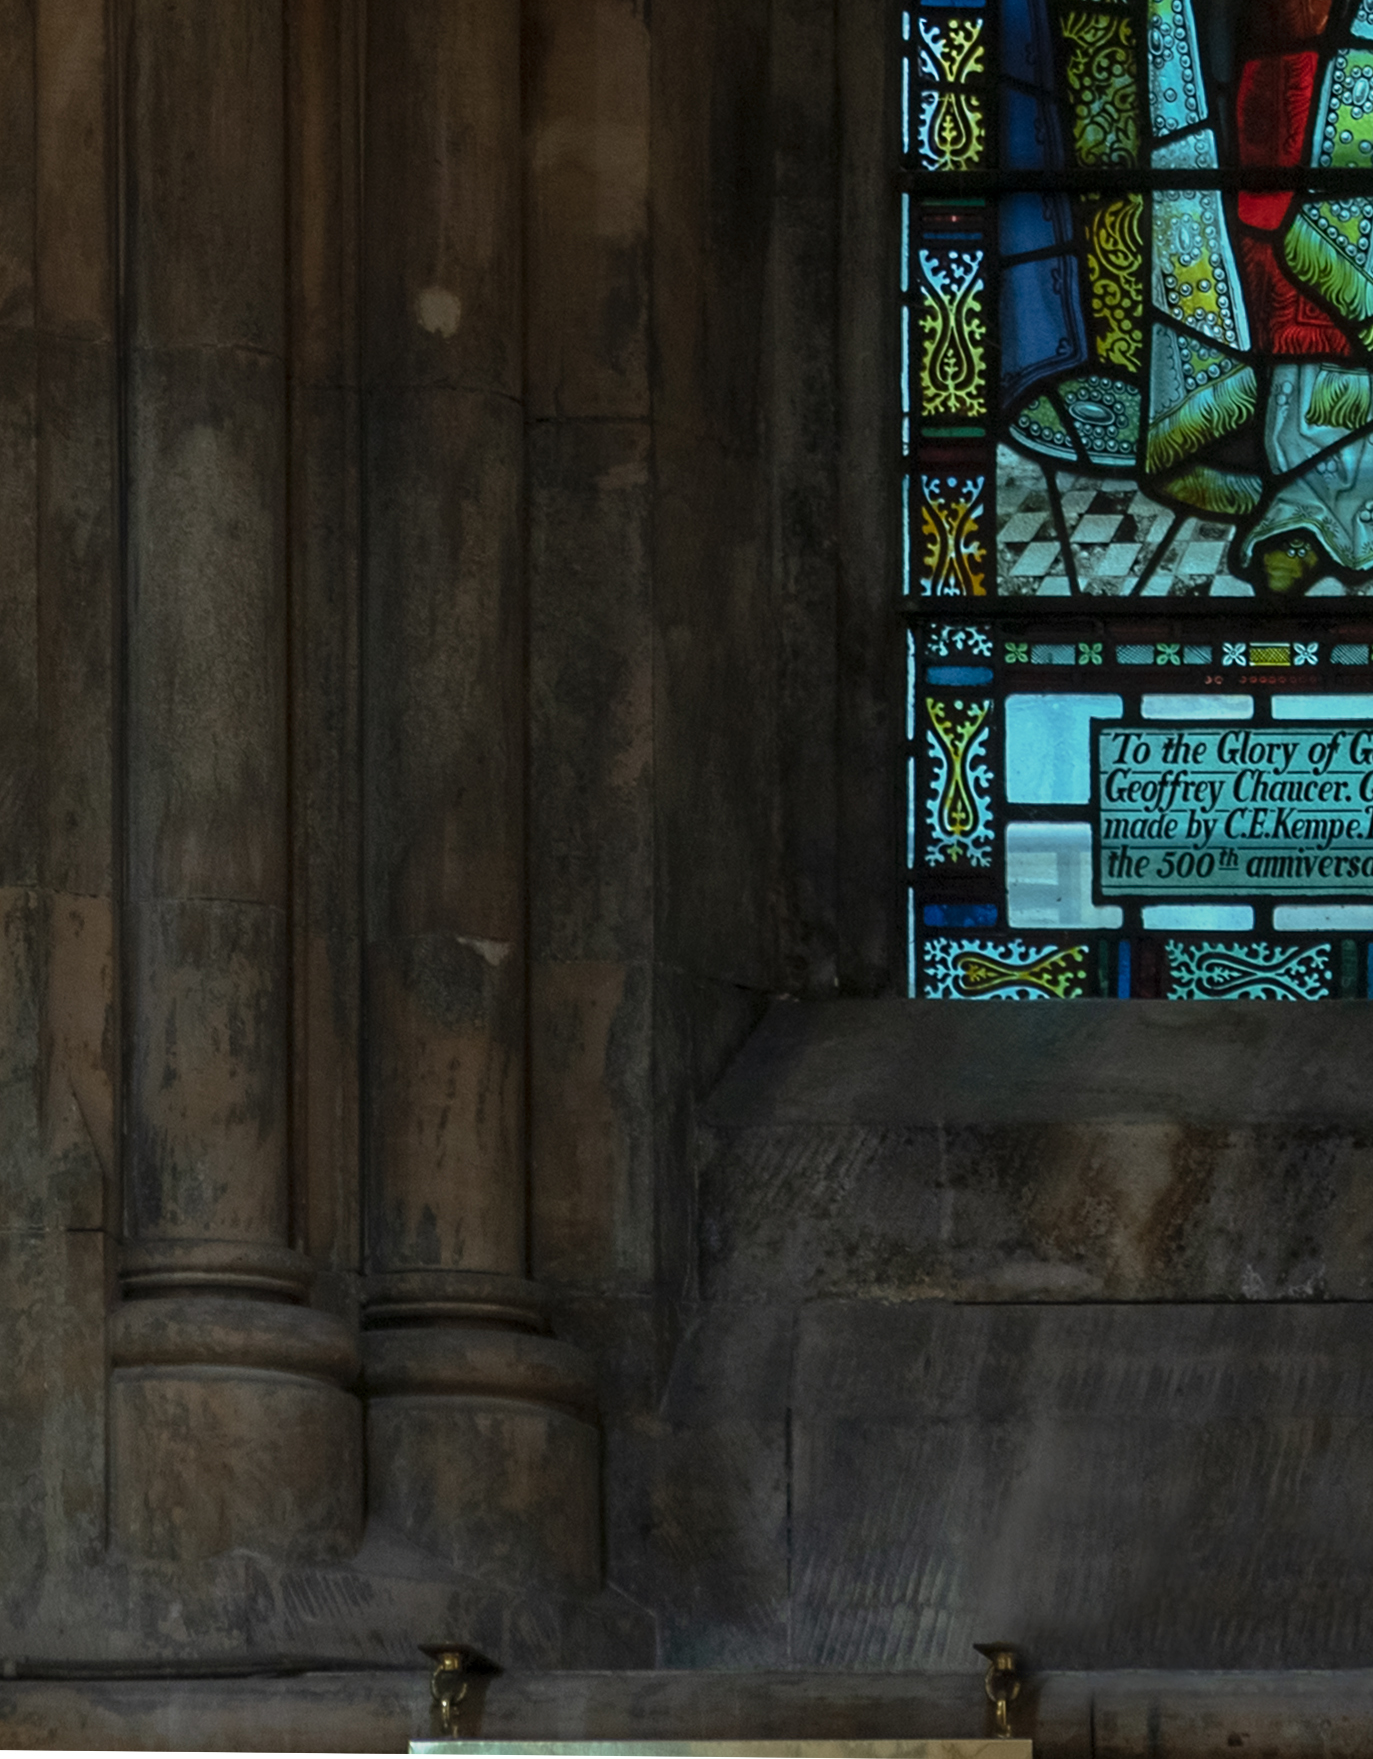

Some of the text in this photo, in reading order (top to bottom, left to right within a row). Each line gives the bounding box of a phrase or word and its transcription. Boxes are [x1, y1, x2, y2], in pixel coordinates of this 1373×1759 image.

[1112, 733, 1150, 765] To
[1162, 734, 1206, 765] the
[1217, 730, 1299, 775] Glory
[1308, 731, 1346, 775] of
[1105, 768, 1225, 812] Geoffrey
[1233, 769, 1351, 802] Chaucer.
[1104, 811, 1178, 839] made
[1187, 809, 1218, 850] by
[1108, 845, 1149, 878] the
